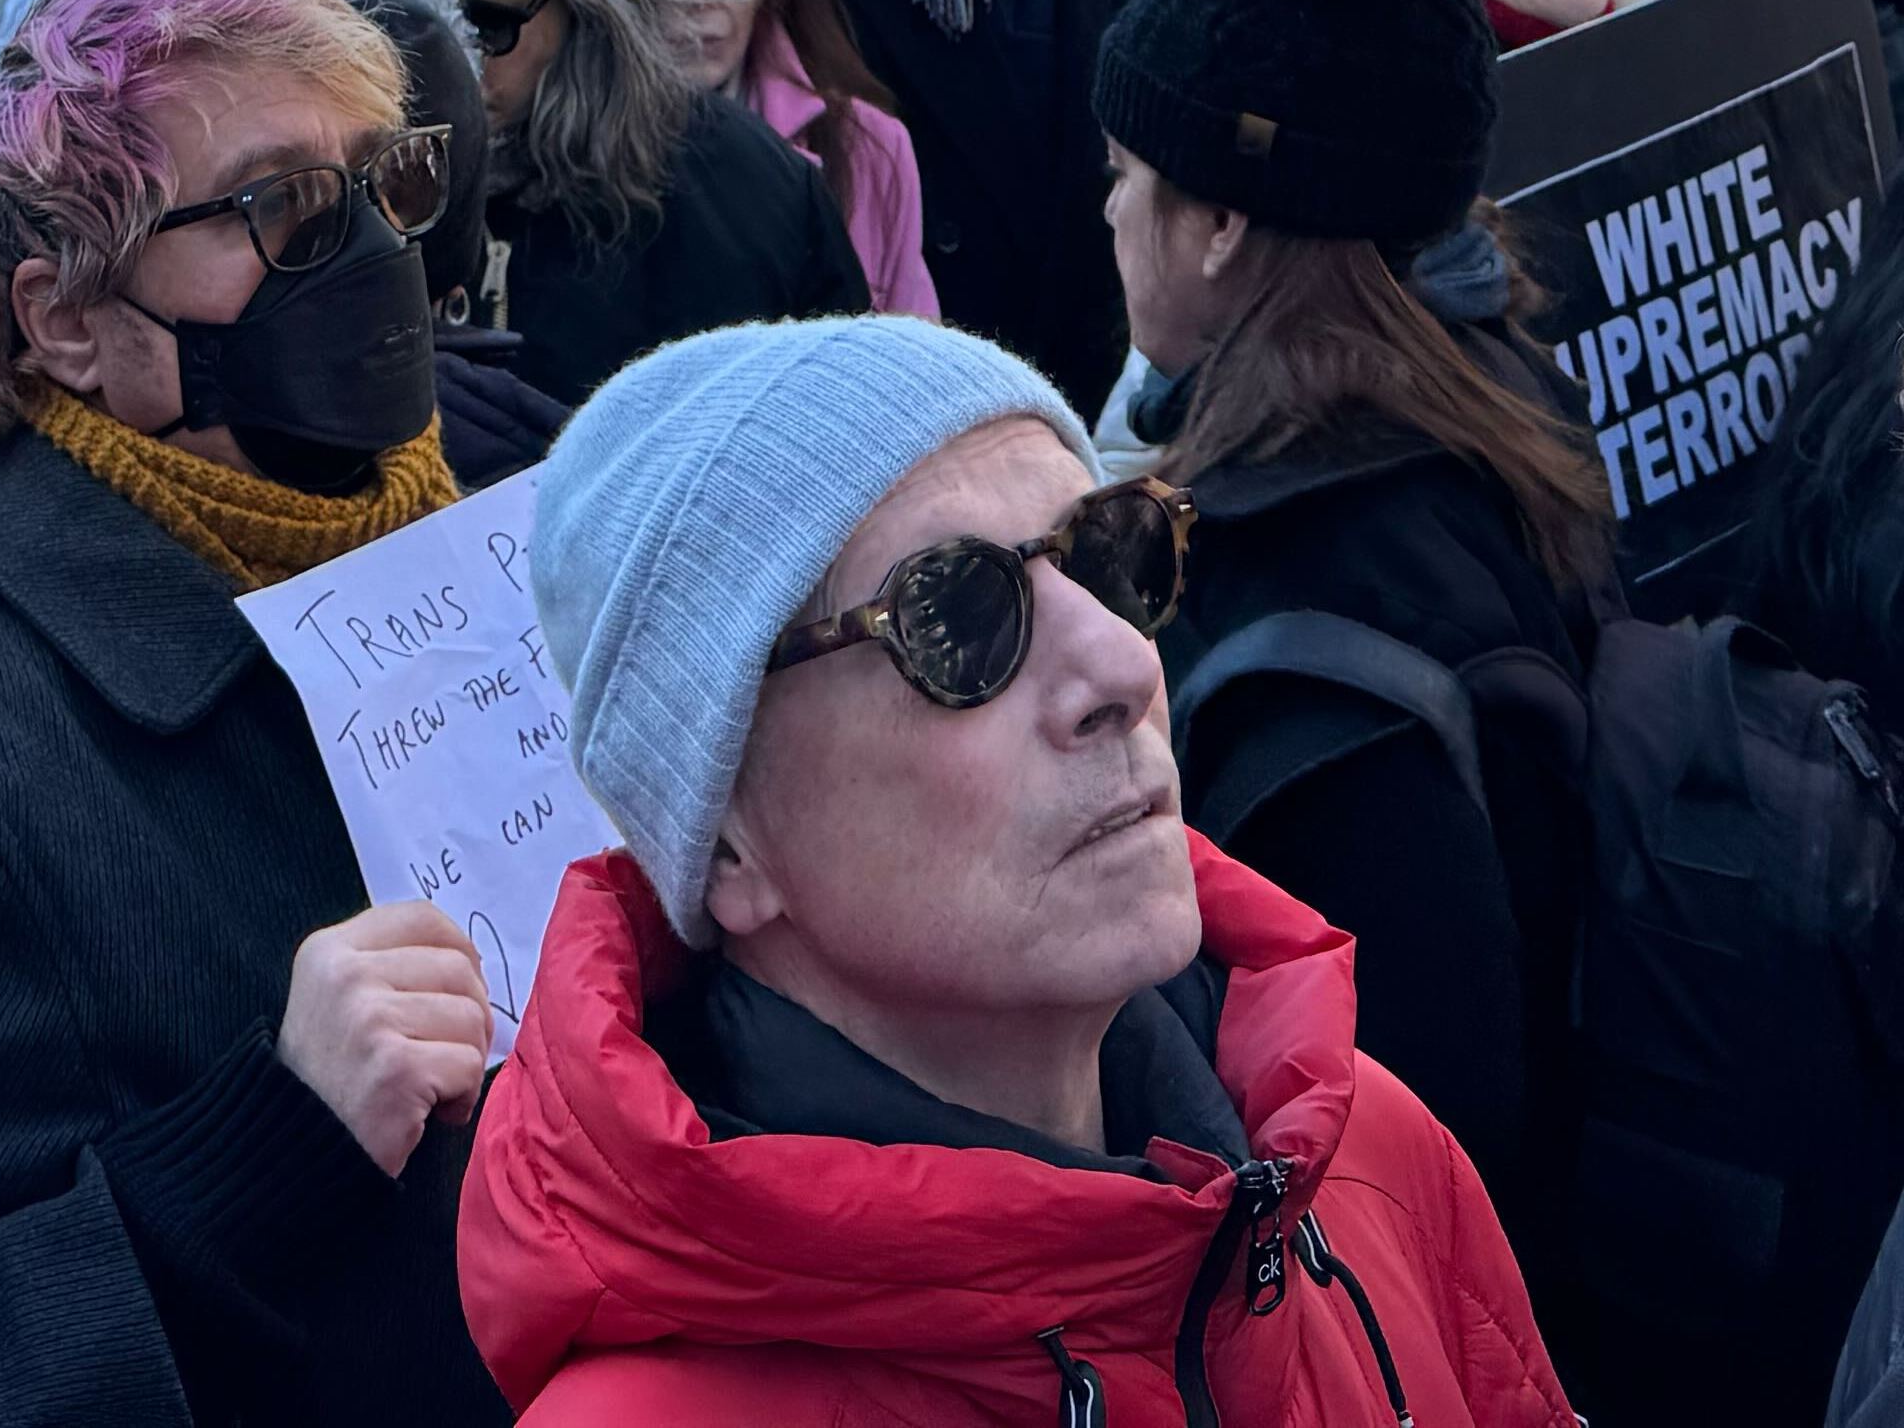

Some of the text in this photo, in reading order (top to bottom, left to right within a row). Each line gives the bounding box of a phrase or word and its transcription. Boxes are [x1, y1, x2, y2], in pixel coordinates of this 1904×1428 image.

[1586, 145, 1782, 309] WHITE
[1555, 197, 1863, 426] UPREMACY
[295, 586, 469, 689] TRANS
[337, 667, 520, 790] THREW THE
[517, 709, 569, 759] AND
[410, 792, 554, 901] WE CAN
[1258, 1254, 1281, 1282] ck
